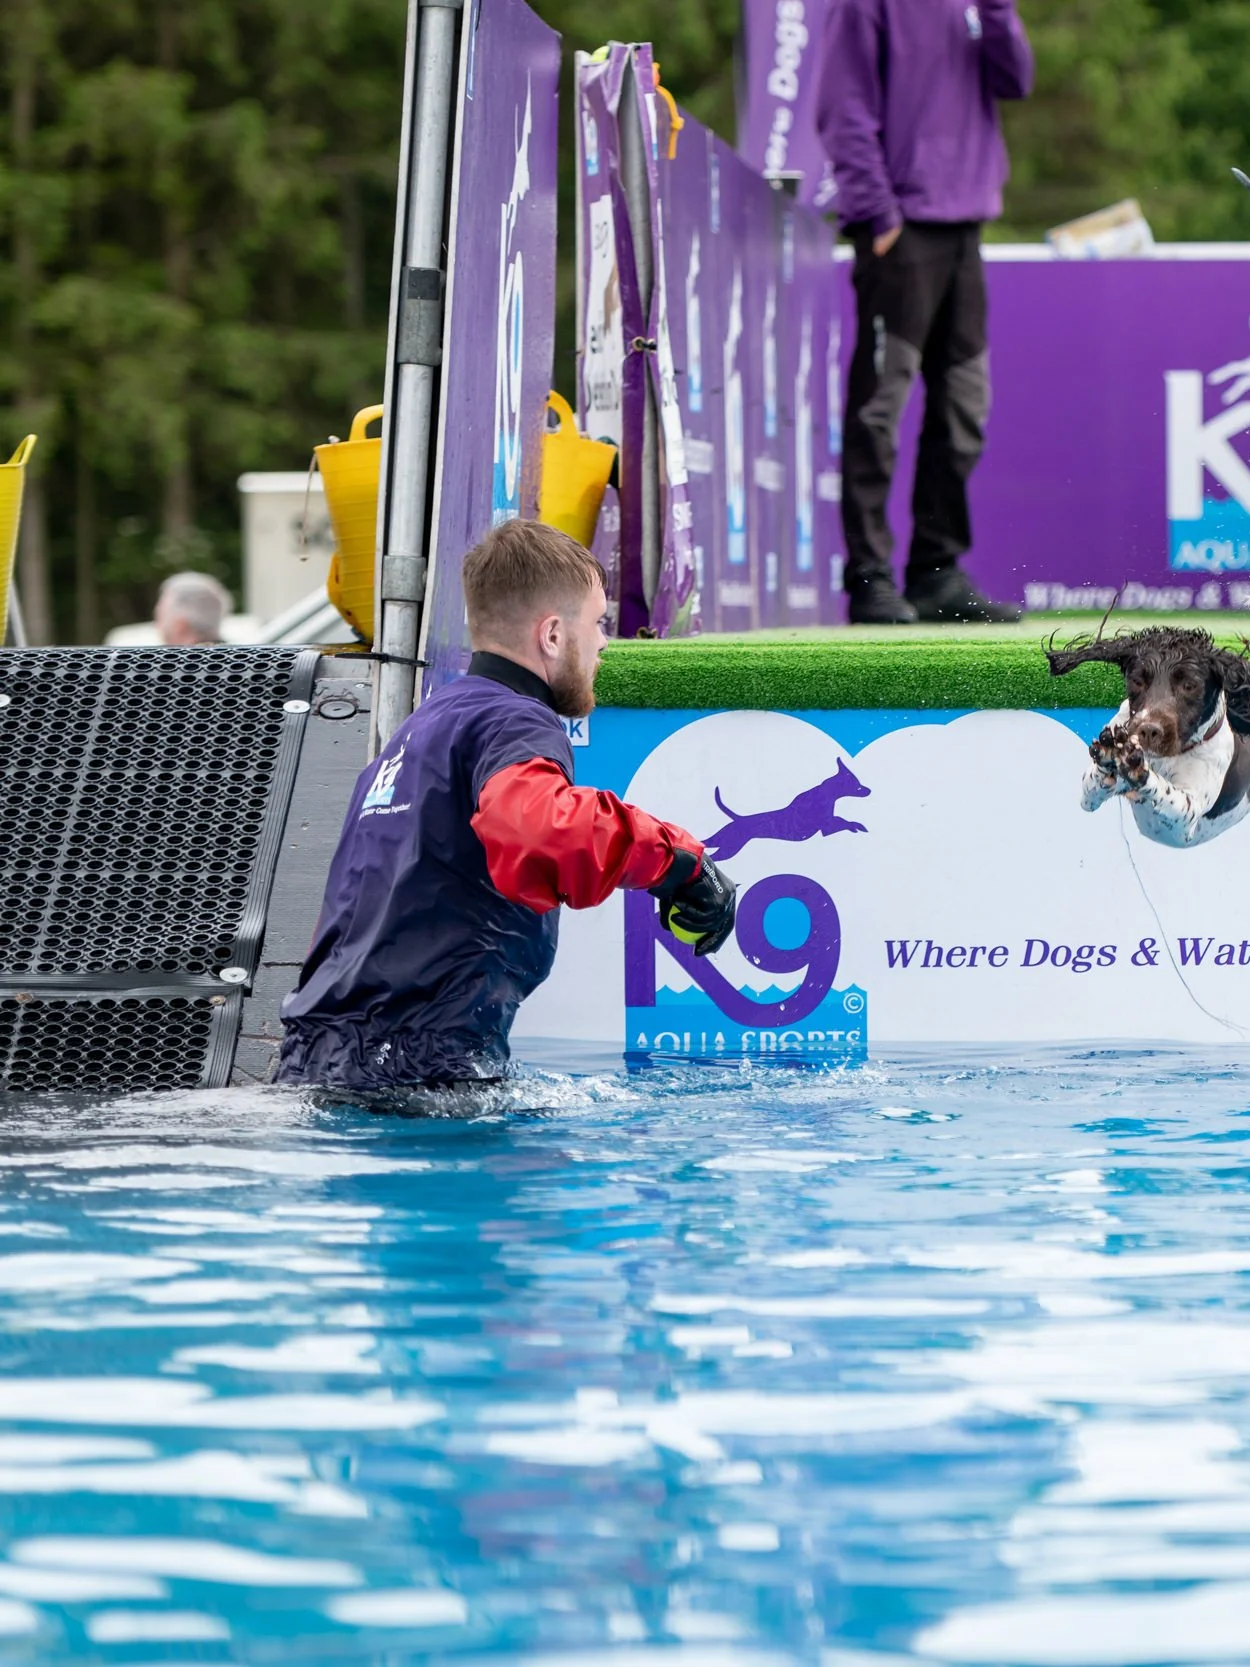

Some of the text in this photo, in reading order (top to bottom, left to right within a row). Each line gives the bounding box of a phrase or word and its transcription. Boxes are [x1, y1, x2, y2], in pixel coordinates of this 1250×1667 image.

[703, 860, 724, 894] TRIBORD
[884, 939, 1010, 969] Where
[1020, 938, 1118, 973] Dogs
[1130, 937, 1160, 967] &
